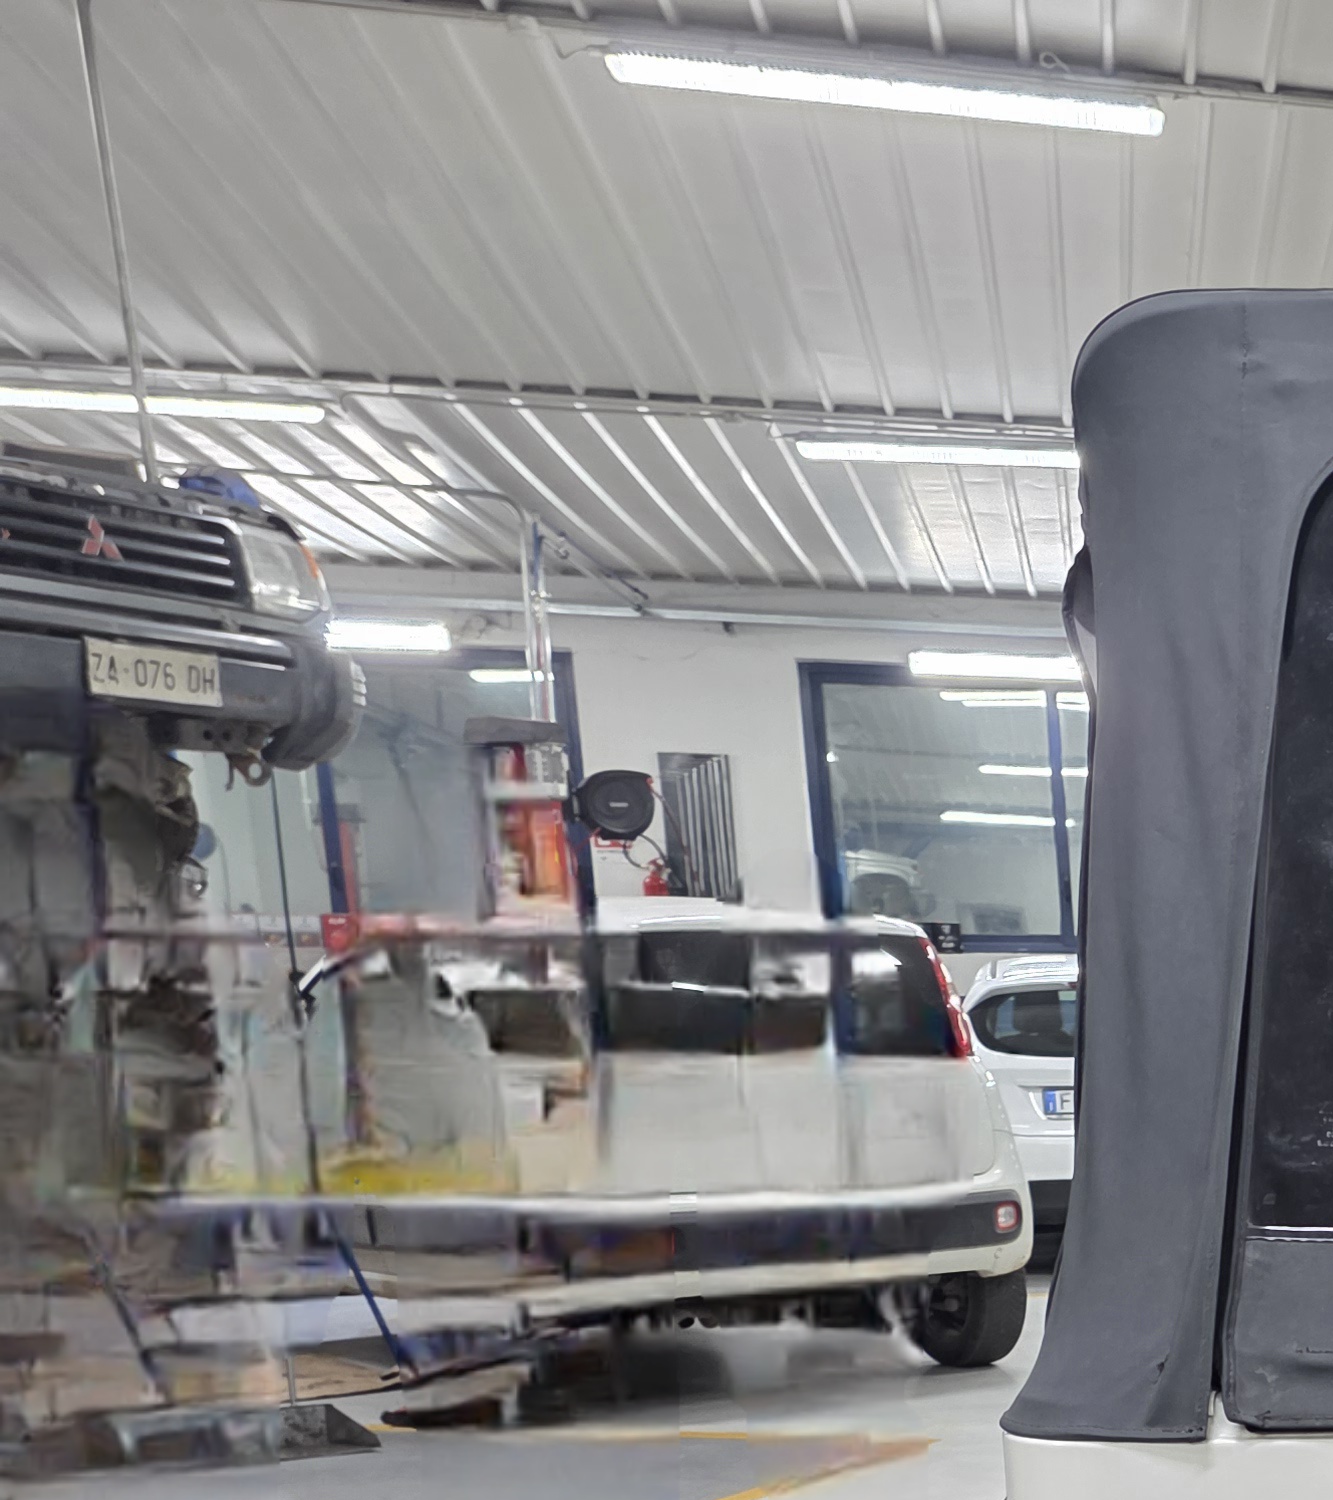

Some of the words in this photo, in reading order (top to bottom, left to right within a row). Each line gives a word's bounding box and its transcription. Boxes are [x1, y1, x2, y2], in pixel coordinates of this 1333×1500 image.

[90, 652, 119, 685] ZA
[134, 659, 176, 691] 076
[187, 664, 216, 695] DH
